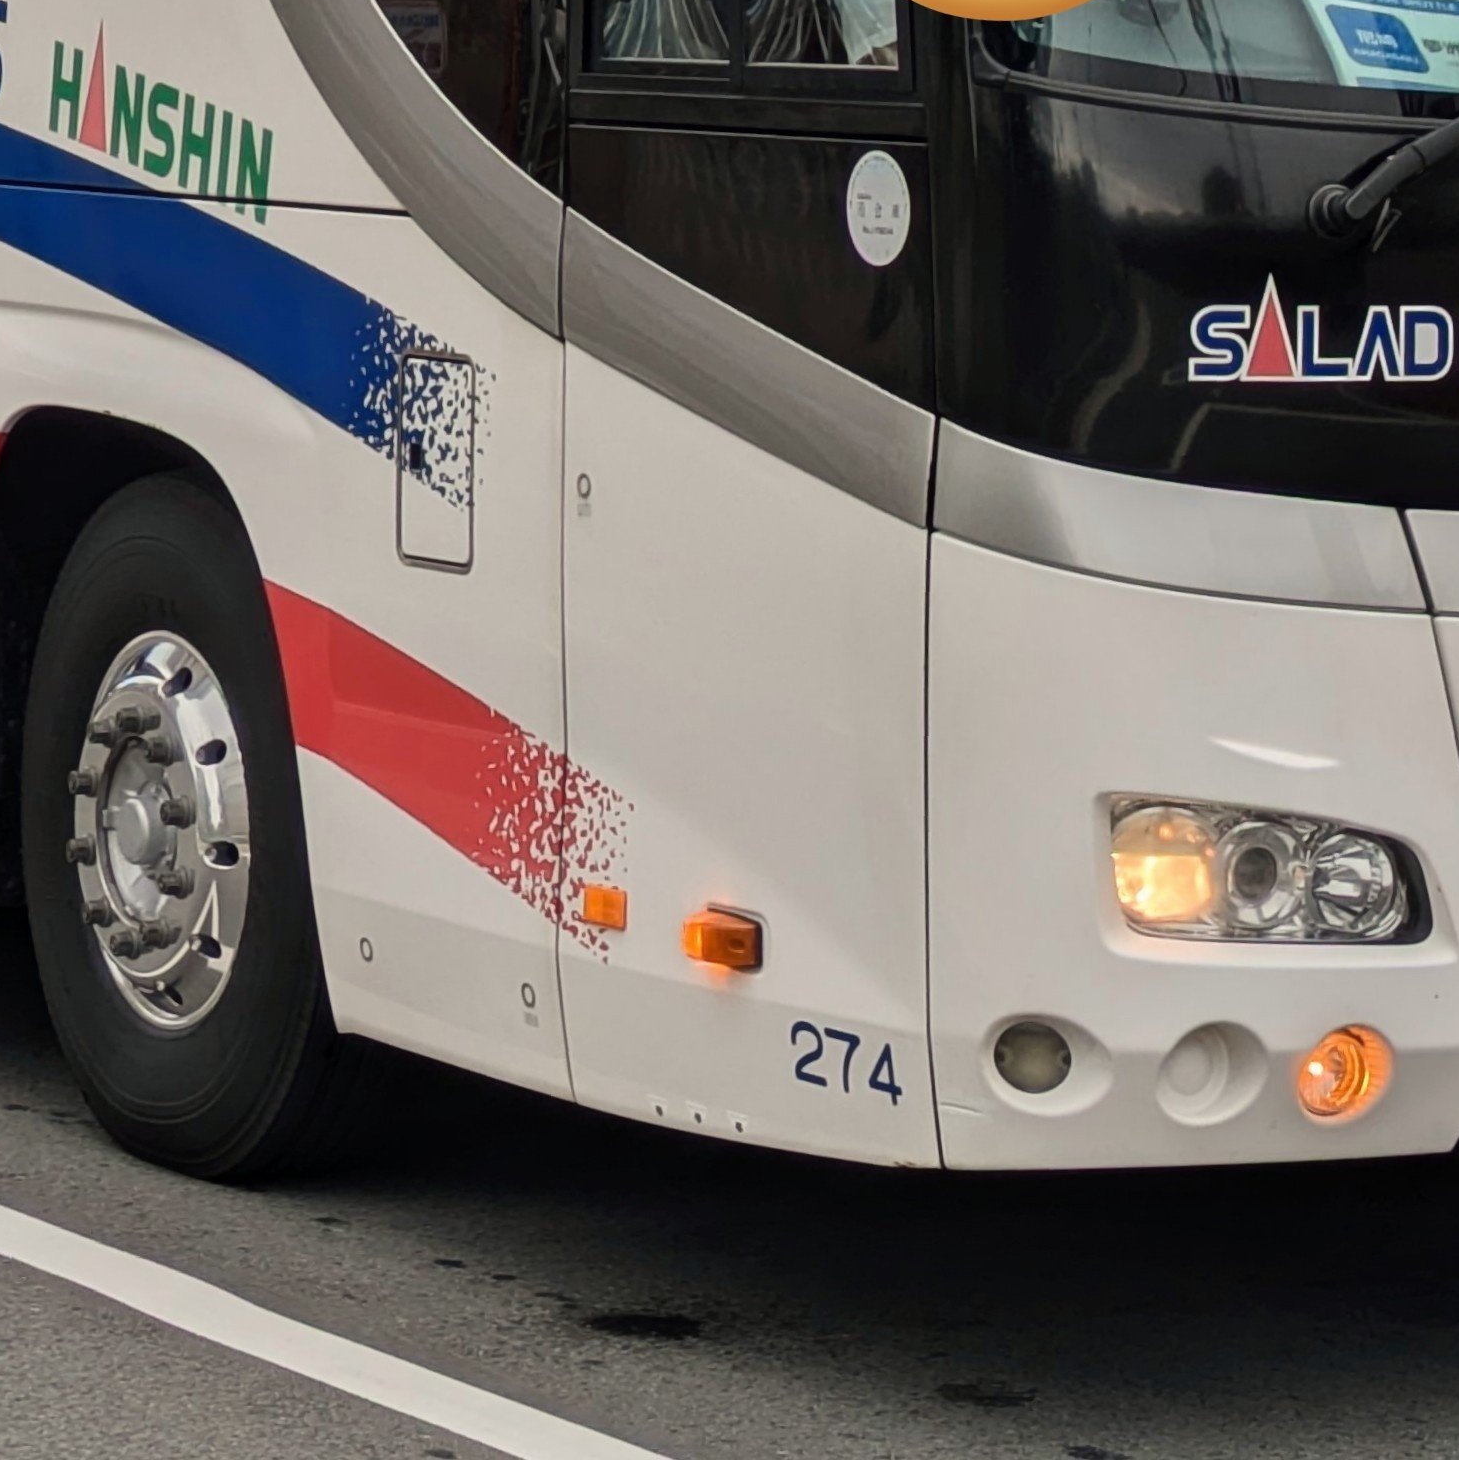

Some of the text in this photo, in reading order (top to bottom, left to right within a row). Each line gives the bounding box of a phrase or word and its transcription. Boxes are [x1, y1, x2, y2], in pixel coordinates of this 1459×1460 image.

[48, 21, 273, 225] HANSHIN
[1188, 272, 1454, 382] SALAD
[790, 1019, 903, 1106] 274
